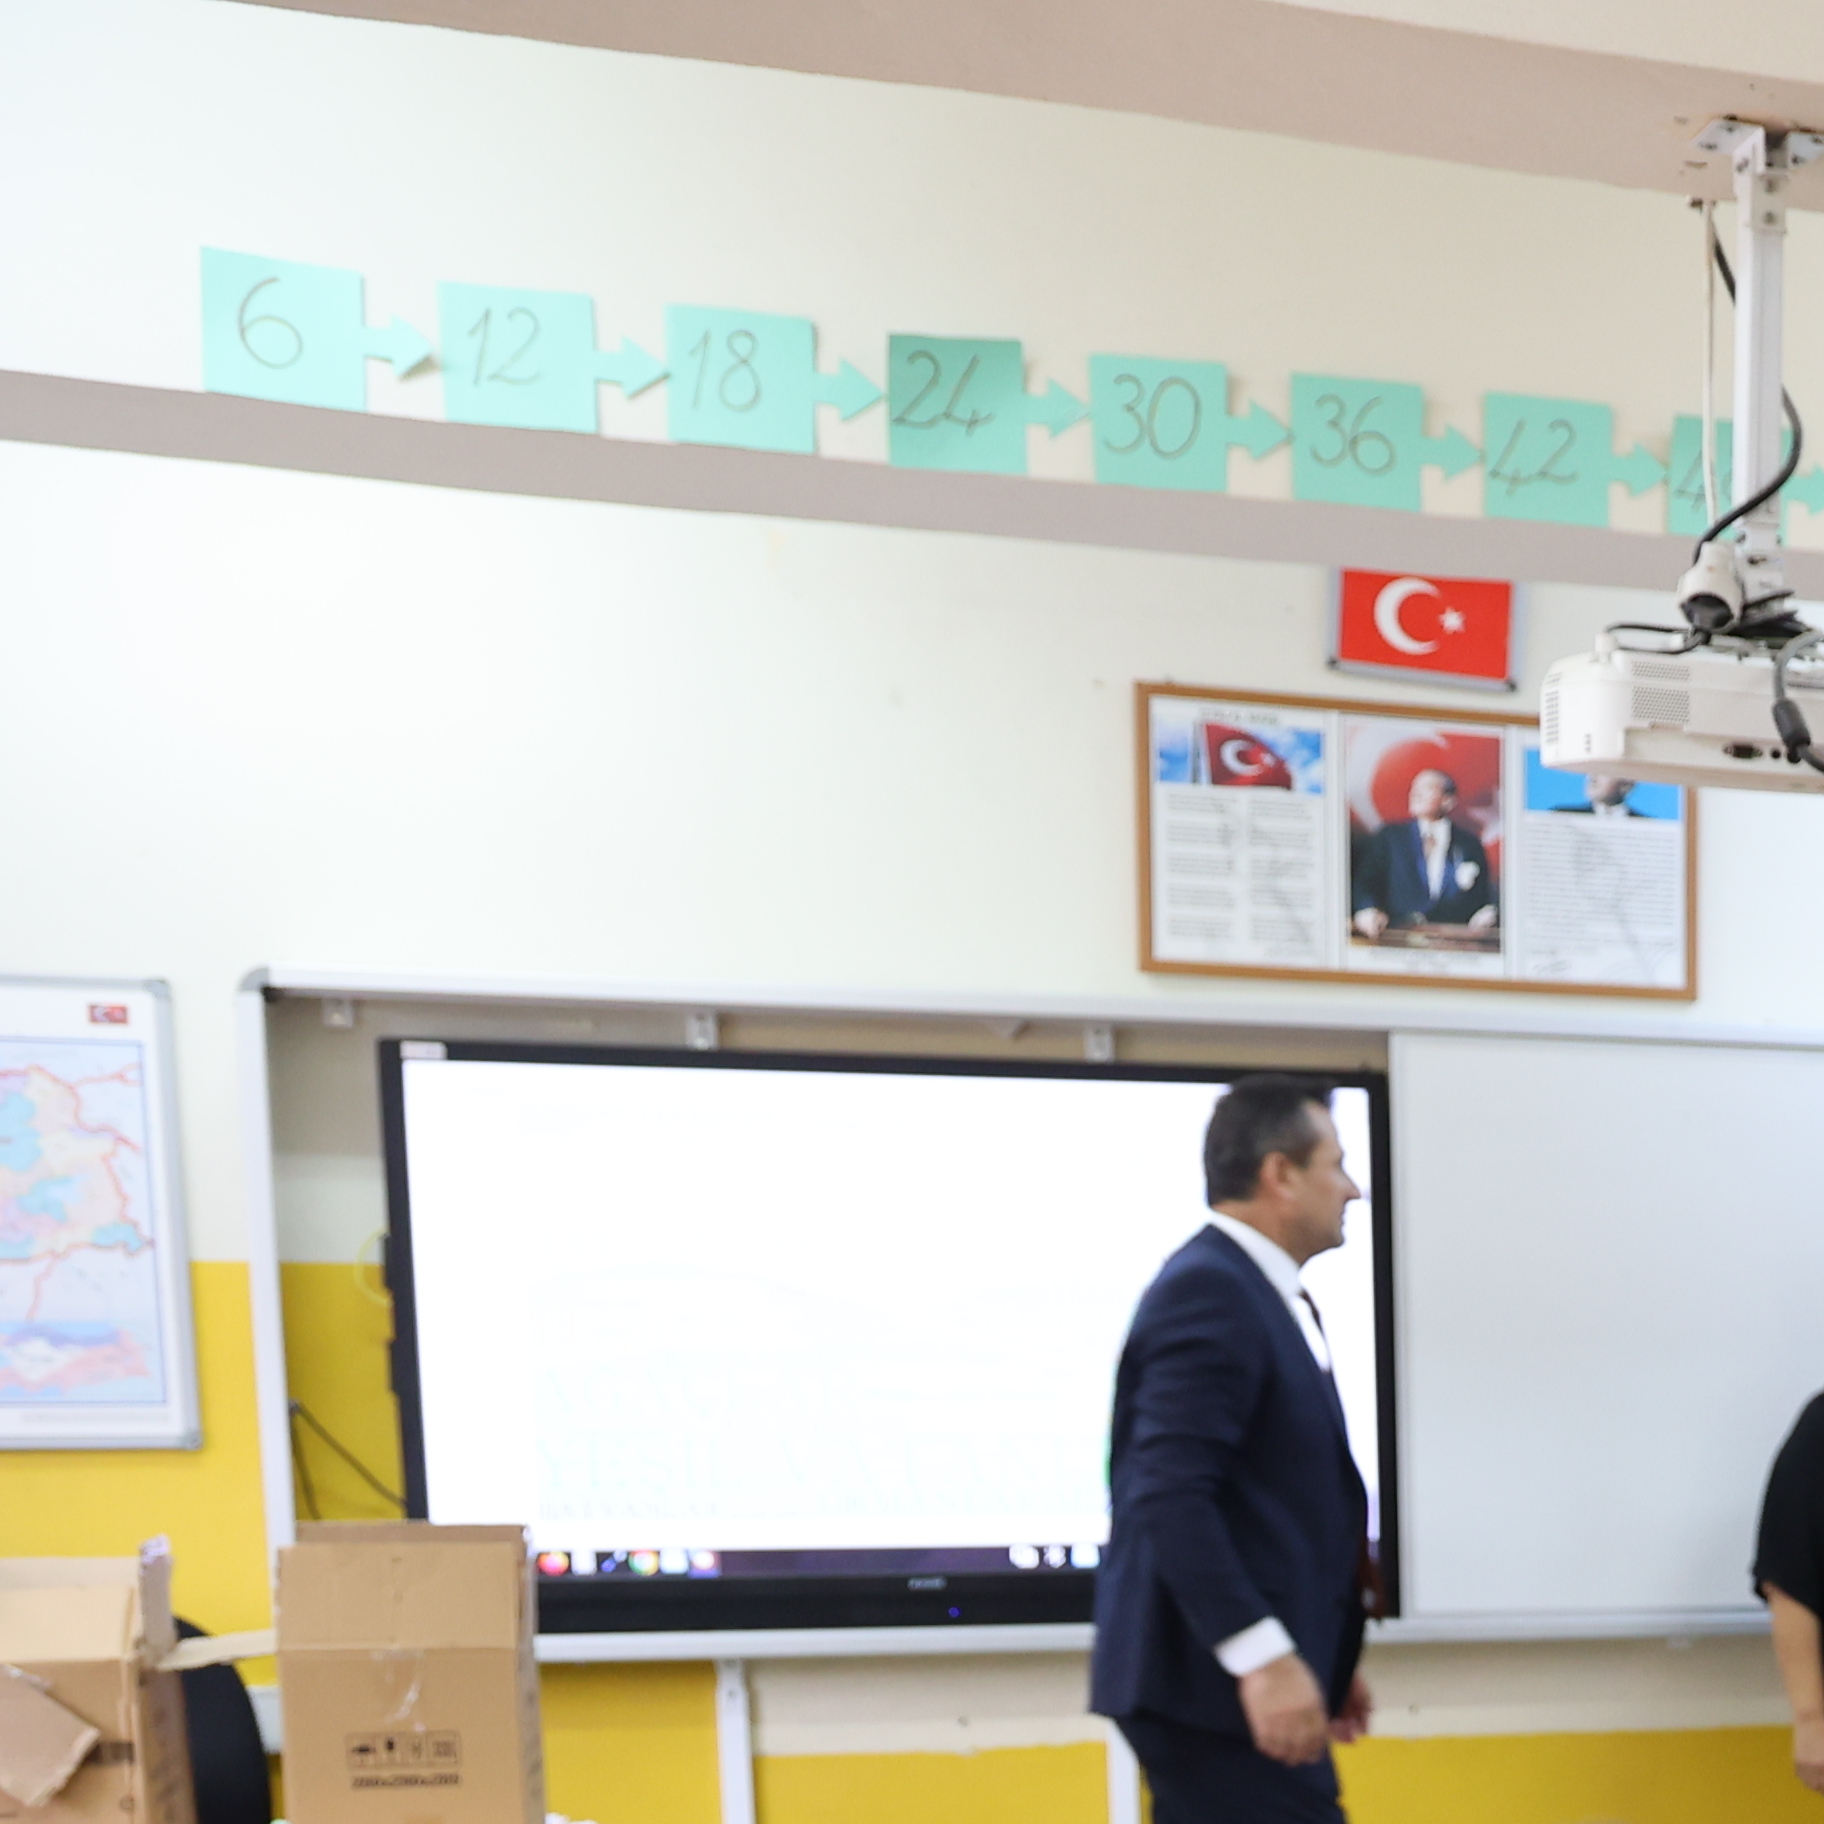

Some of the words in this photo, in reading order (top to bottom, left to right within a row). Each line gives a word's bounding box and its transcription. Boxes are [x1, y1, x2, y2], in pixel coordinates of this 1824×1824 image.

[237, 276, 303, 369] 6
[466, 305, 541, 388] 12
[687, 327, 763, 413] 18
[892, 348, 996, 436] 24
[1101, 372, 1200, 459] 30
[1309, 392, 1396, 476] 36
[1487, 417, 1580, 496] 42
